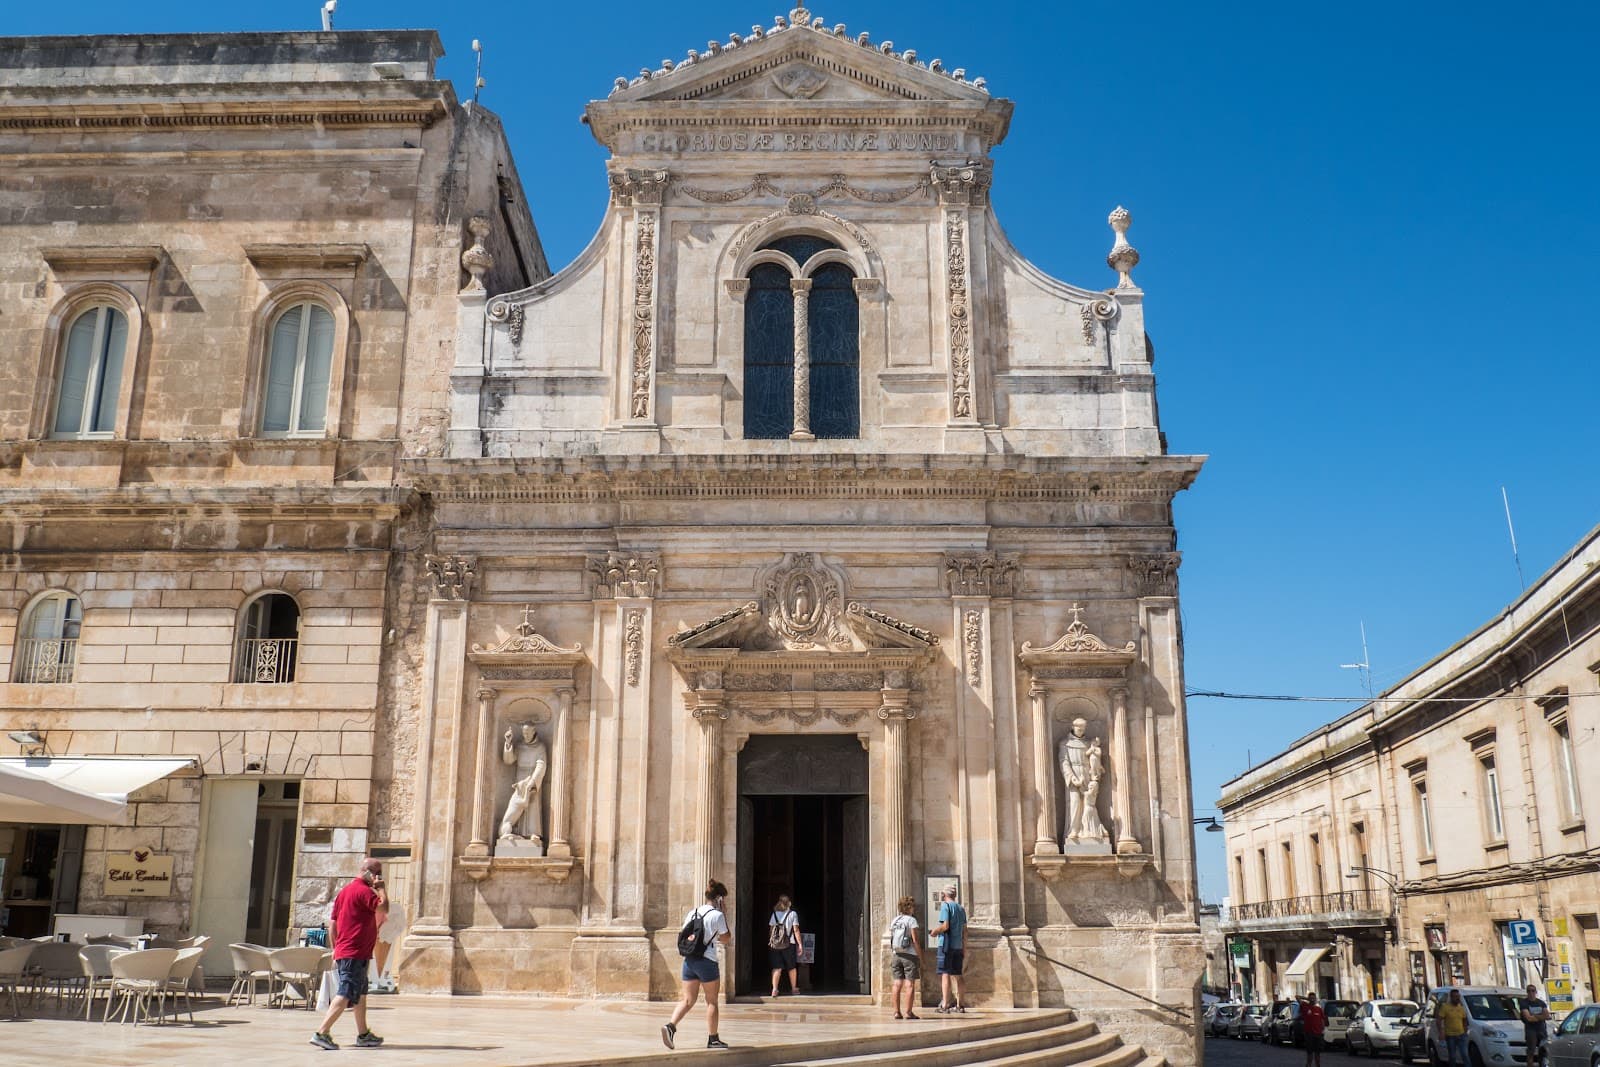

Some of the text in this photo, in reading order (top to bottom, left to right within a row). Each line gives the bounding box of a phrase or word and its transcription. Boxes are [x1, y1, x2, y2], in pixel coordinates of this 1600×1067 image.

[888, 133, 958, 151] MUNDI
[136, 869, 169, 882] Centrale
[1514, 923, 1531, 943] P
